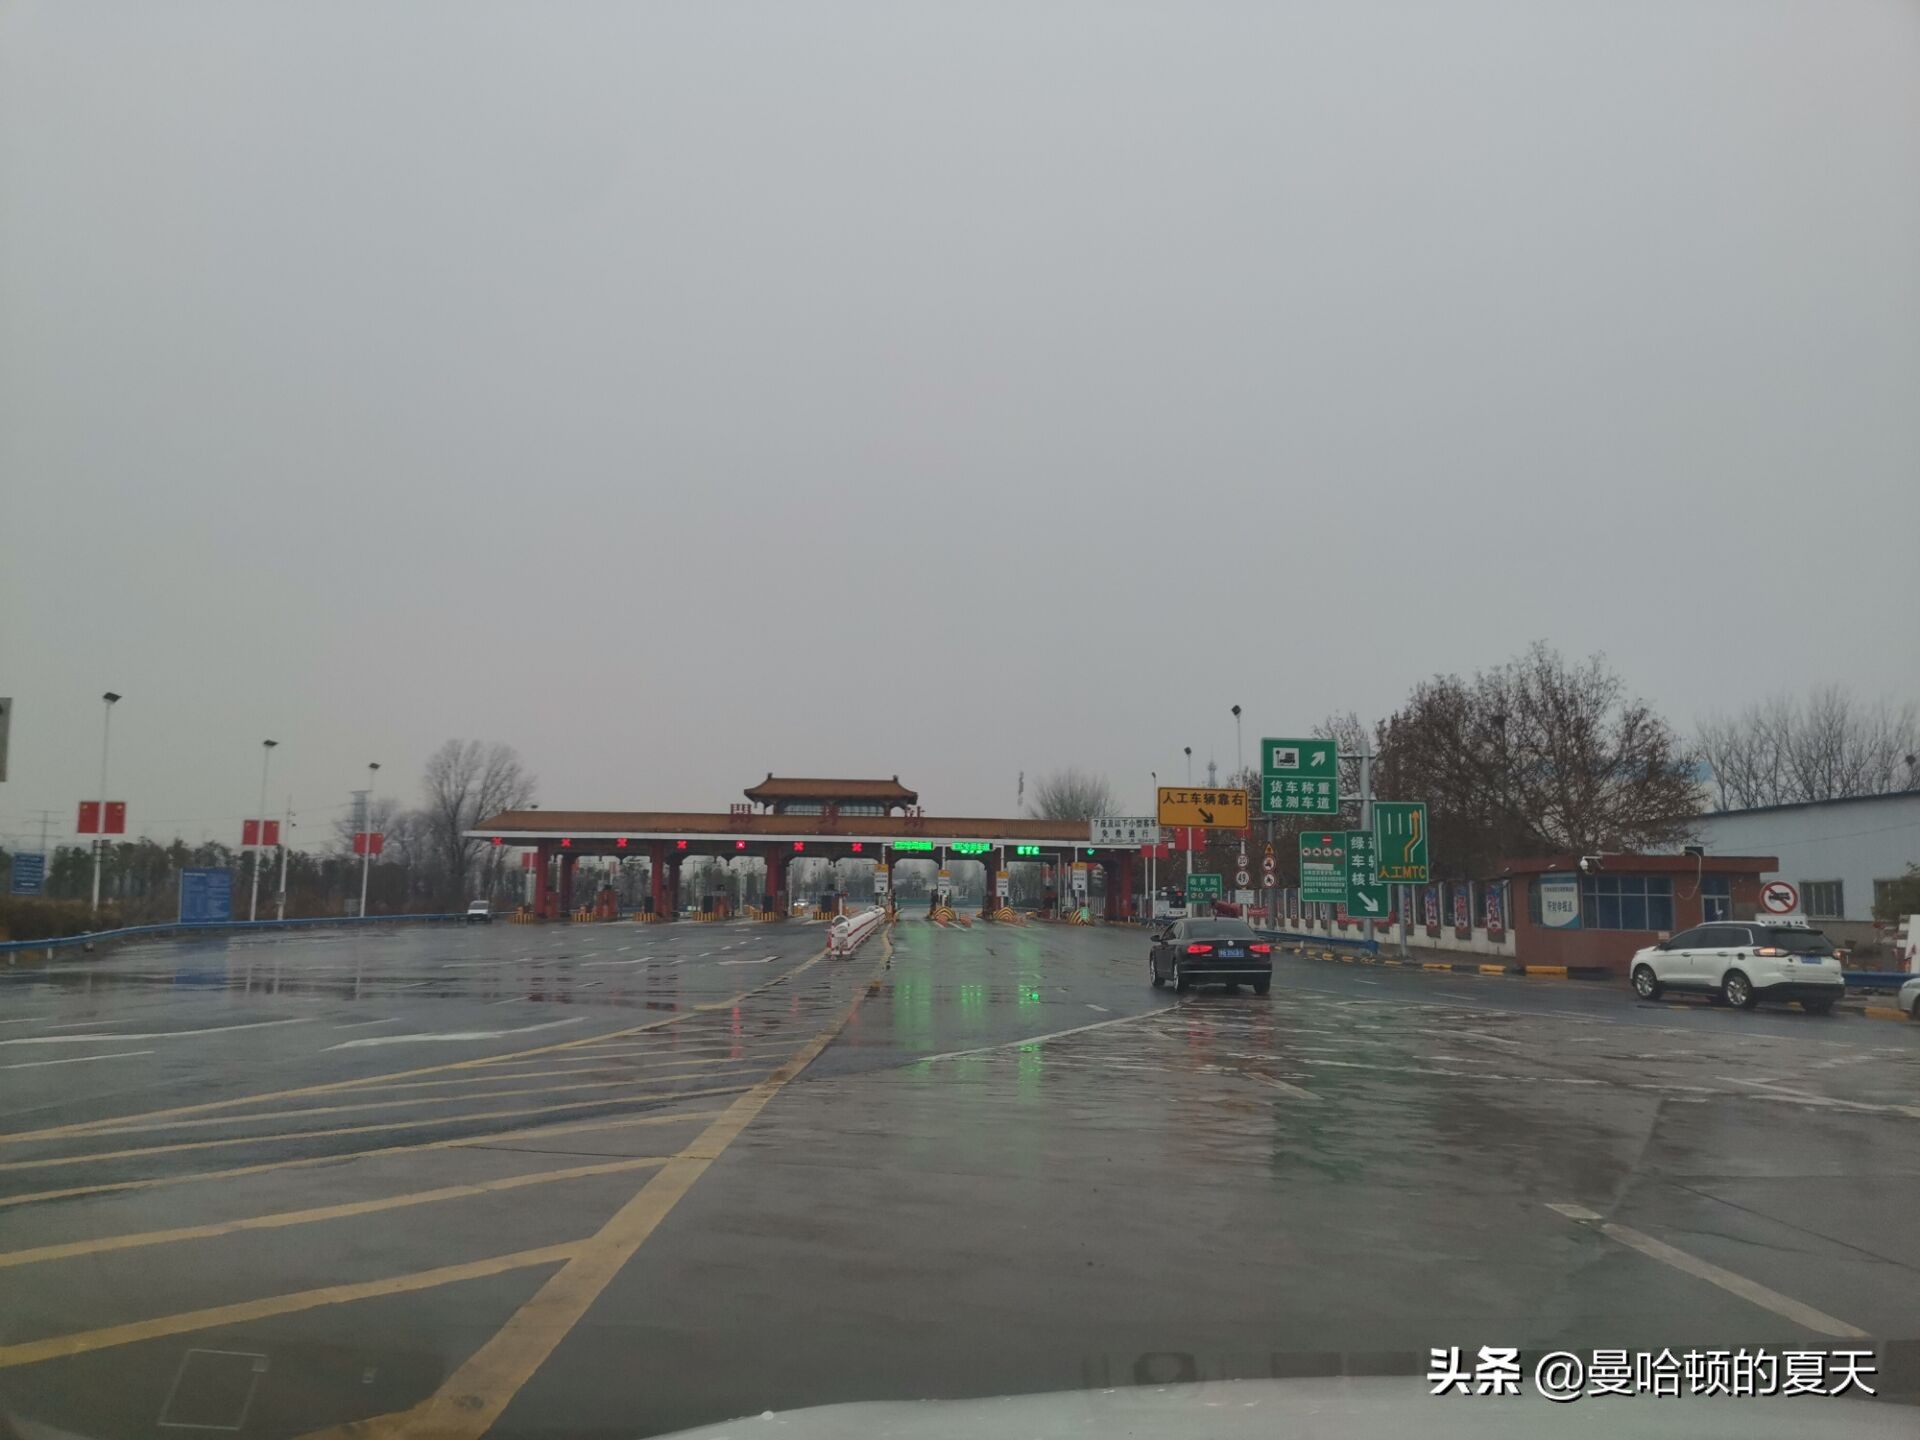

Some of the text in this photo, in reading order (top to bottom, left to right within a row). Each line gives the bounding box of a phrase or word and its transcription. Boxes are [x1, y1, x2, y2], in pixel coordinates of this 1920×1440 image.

[1270, 780, 1330, 794] 货车称重
[1163, 791, 1244, 805] 人工车辆靠右
[1270, 795, 1330, 809] 检测车道
[1102, 829, 1149, 838] 免费通行
[1017, 845, 1040, 855] ETC
[1378, 865, 1426, 879] 人工MTC
